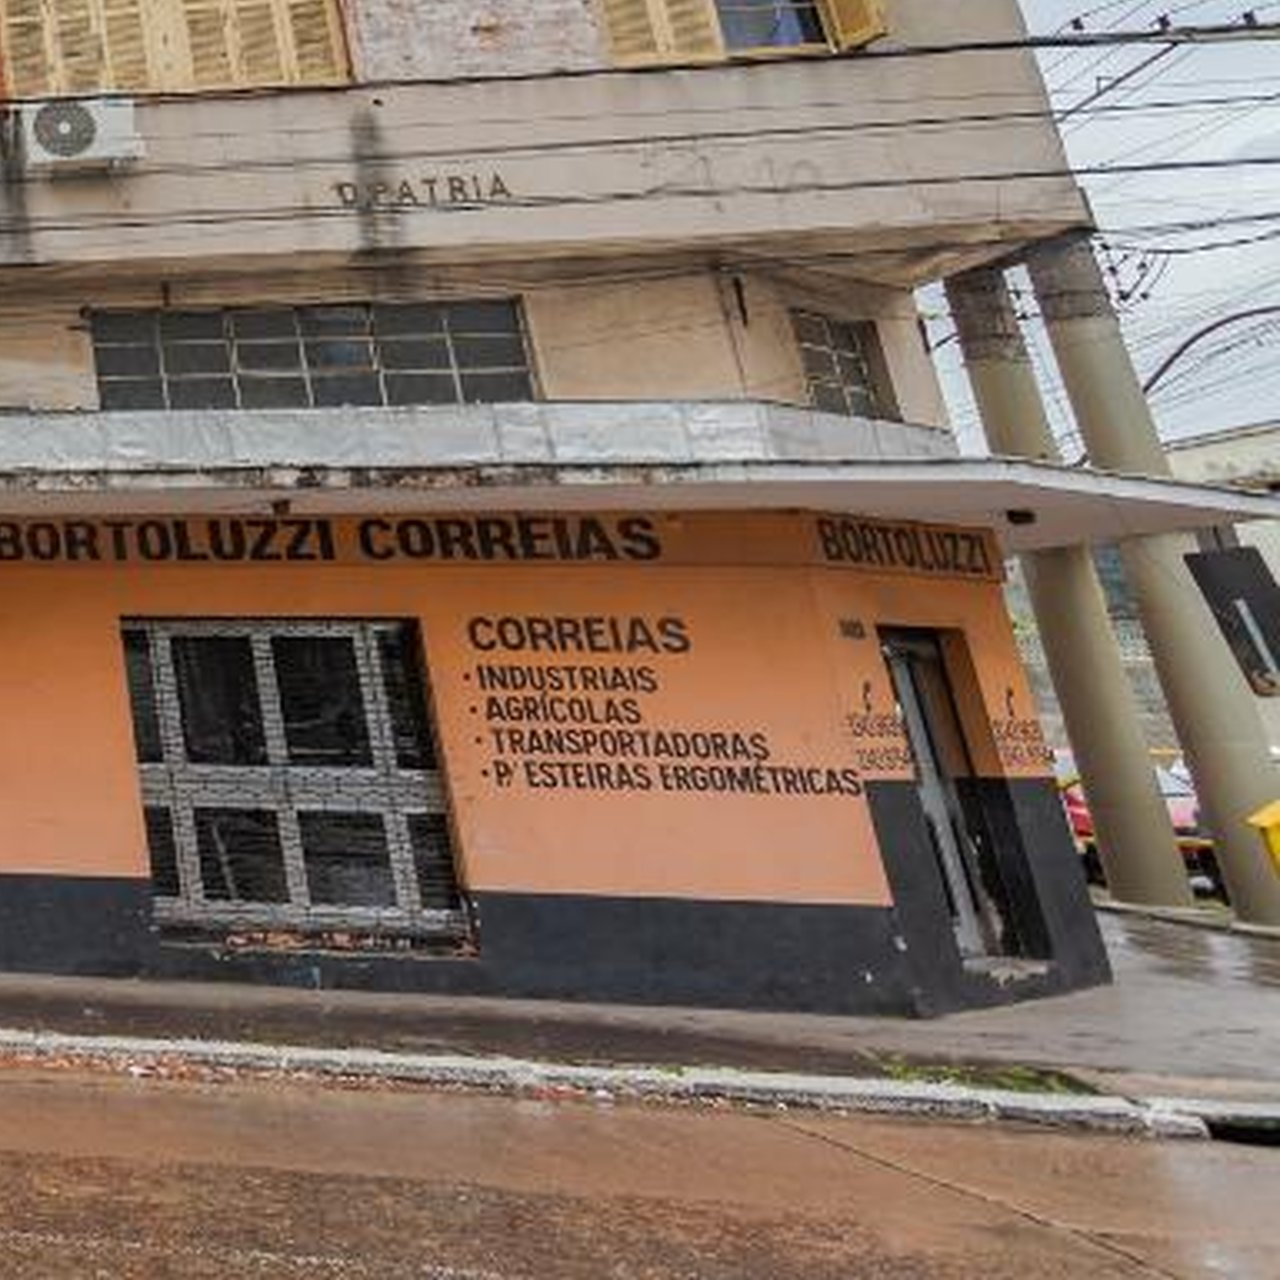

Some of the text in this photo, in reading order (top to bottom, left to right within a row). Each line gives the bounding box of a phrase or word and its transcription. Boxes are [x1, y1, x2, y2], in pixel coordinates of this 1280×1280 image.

[359, 516, 662, 561] CORREIAS
[817, 518, 992, 577] BORTOLUZZI
[468, 617, 692, 654] CORREIAS
[477, 666, 659, 694] INDUSTRIAIS
[485, 692, 642, 724] AGRÍCOLAS
[492, 729, 771, 761] TRANSPORTADORAS
[524, 762, 653, 791] ESTEIRAS
[661, 762, 863, 798] ERGOMÉTRICAS
